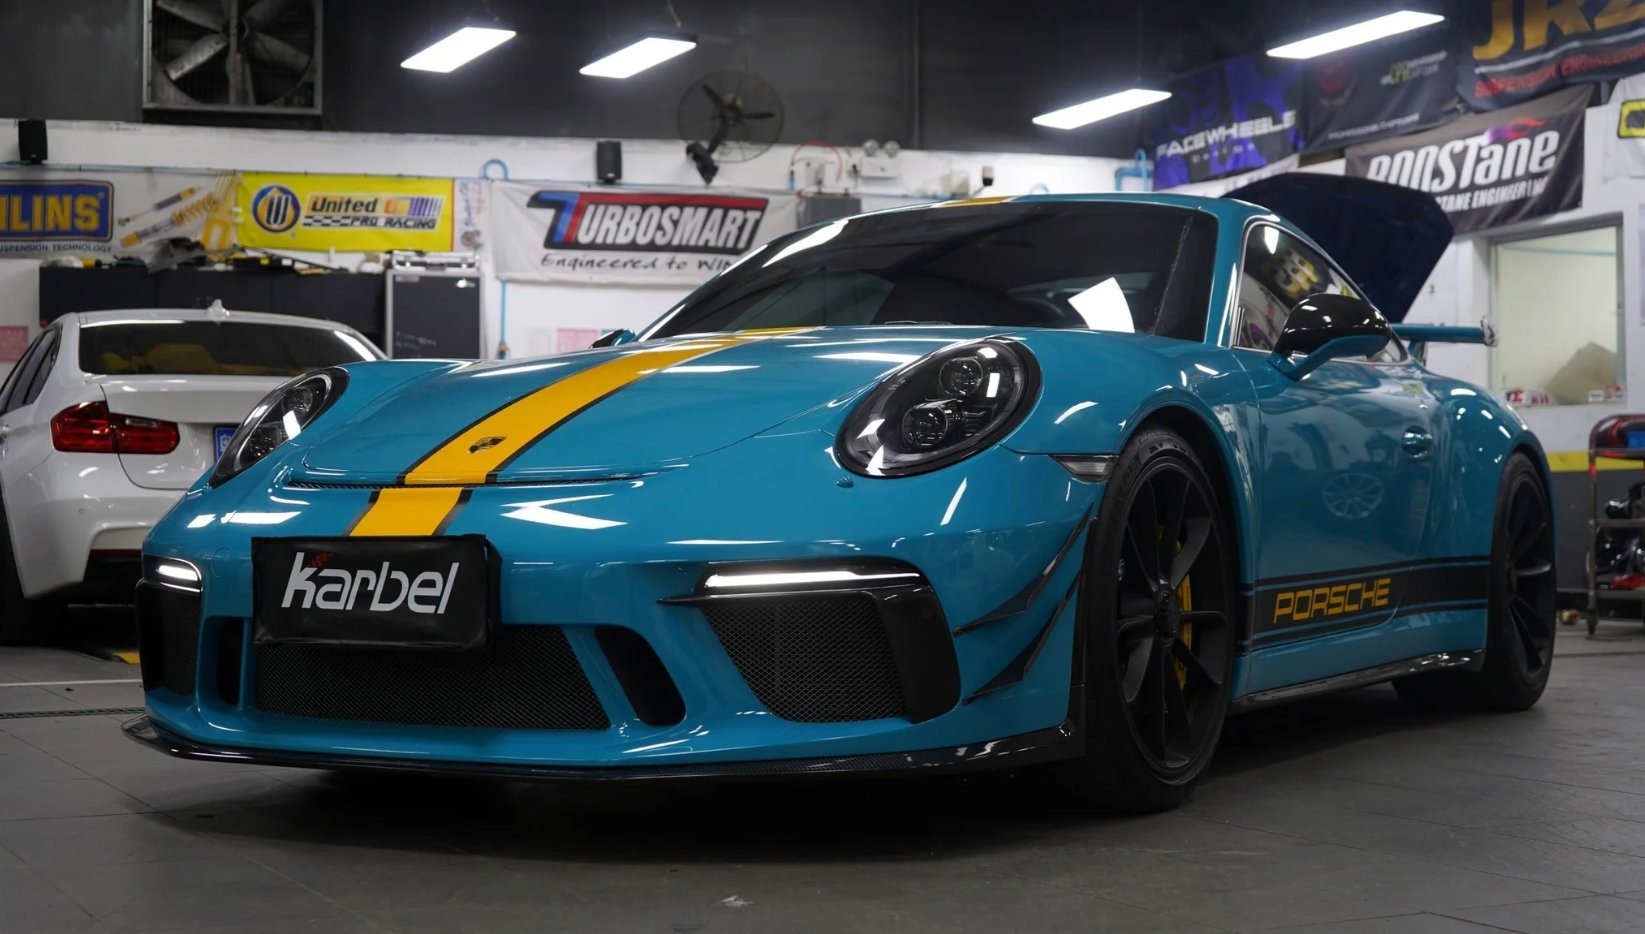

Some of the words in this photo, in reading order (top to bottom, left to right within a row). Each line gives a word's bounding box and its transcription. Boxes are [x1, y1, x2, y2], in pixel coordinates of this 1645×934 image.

[1156, 110, 1296, 160] FACEWHEELS
[311, 196, 378, 214] United
[350, 216, 378, 227] PRO
[384, 217, 437, 229] RACING
[527, 190, 769, 255] TURBOSMART
[52, 244, 112, 253] TECHNOLOGY
[541, 254, 656, 271] Engineered
[668, 256, 688, 270] to
[281, 552, 459, 614] karbel
[1273, 577, 1391, 624] PORSCHE
